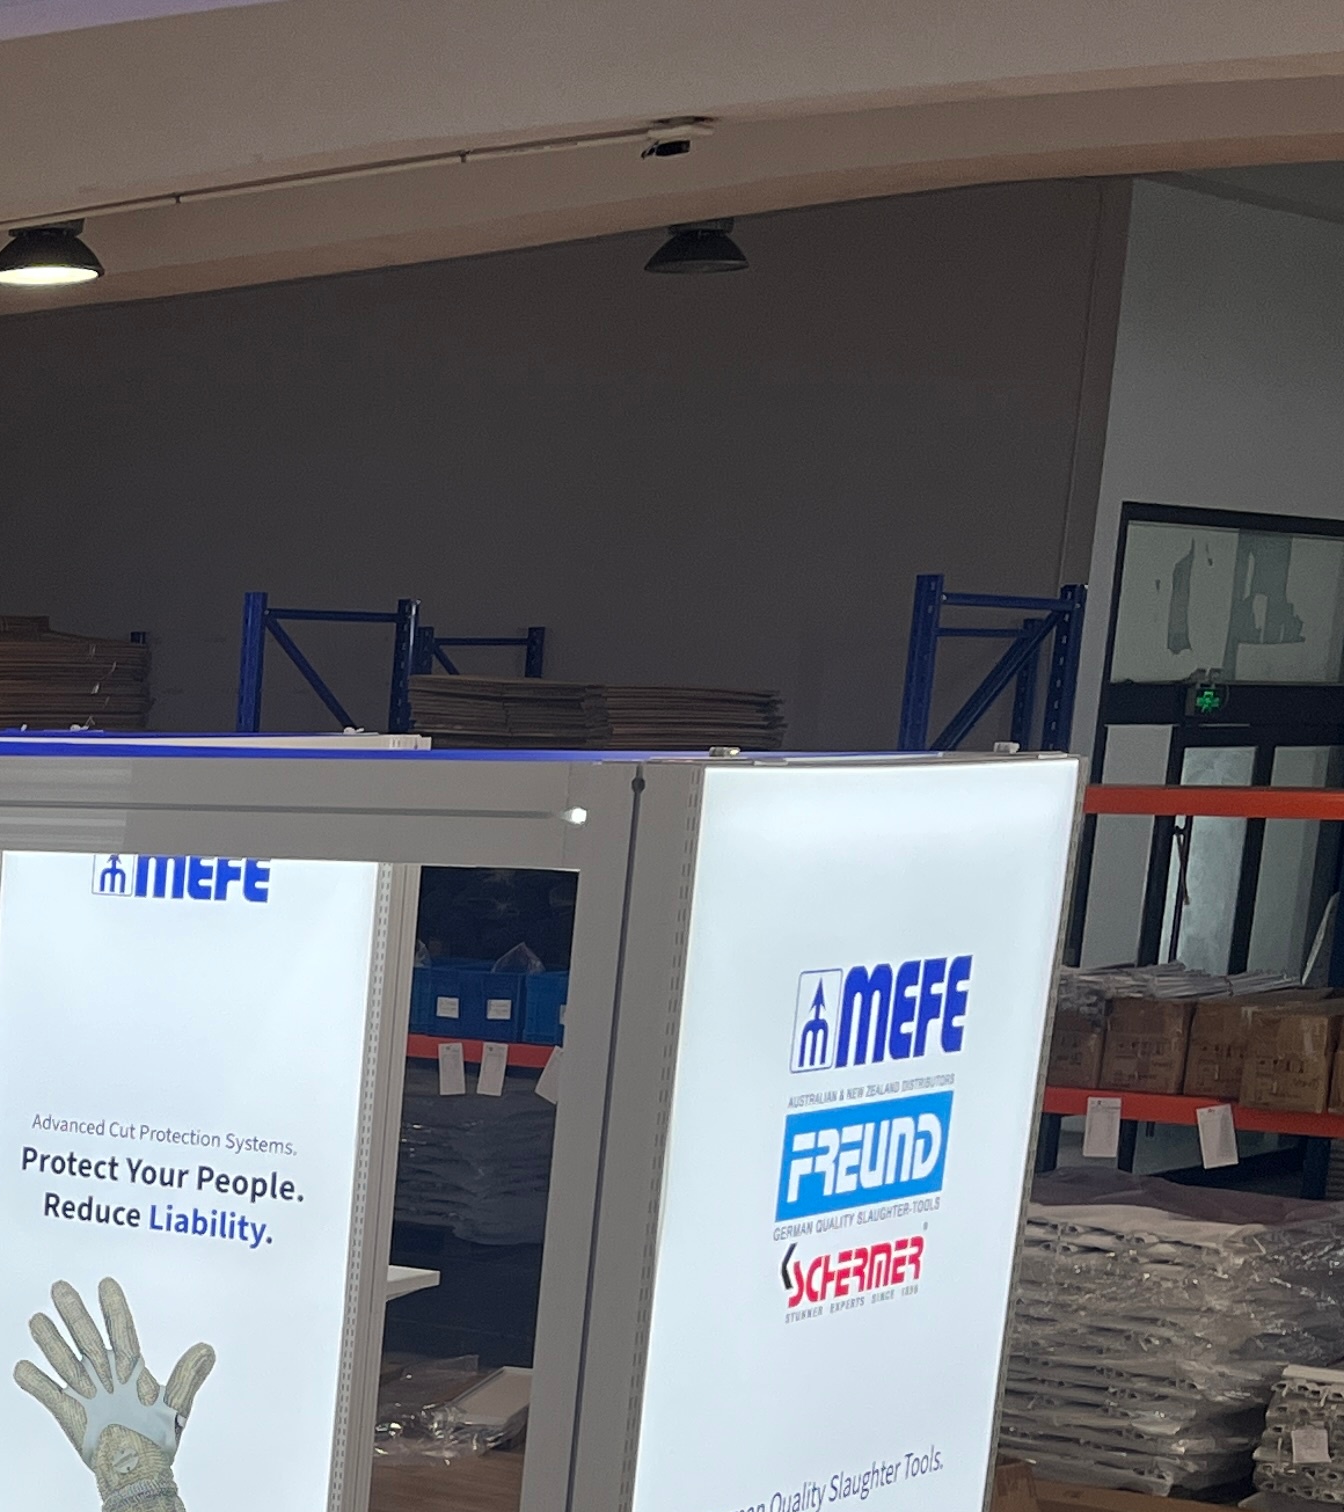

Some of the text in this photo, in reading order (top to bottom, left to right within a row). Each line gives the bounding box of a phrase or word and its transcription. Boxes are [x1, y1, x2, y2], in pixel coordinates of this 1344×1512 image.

[134, 854, 271, 903] MEFE
[834, 954, 973, 1068] MEFE
[787, 1090, 837, 1109] AUSTRALIAN
[846, 1086, 864, 1100] NEW
[865, 1081, 900, 1097] ZEALAND
[901, 1073, 955, 1092] DISTRIBUTORS
[31, 1113, 298, 1156] Advanced Cut Protection Systems.
[787, 1112, 943, 1204] FREUND
[21, 1146, 305, 1203] Protect Your People.
[43, 1192, 273, 1249] Reduce Liability.
[773, 1196, 941, 1242] GERMAN QUALITY SLAUGHTER-TOOLS
[787, 1236, 925, 1309] SCHERMER
[828, 1458, 902, 1502] Slaughter
[904, 1445, 944, 1481] Tools.
